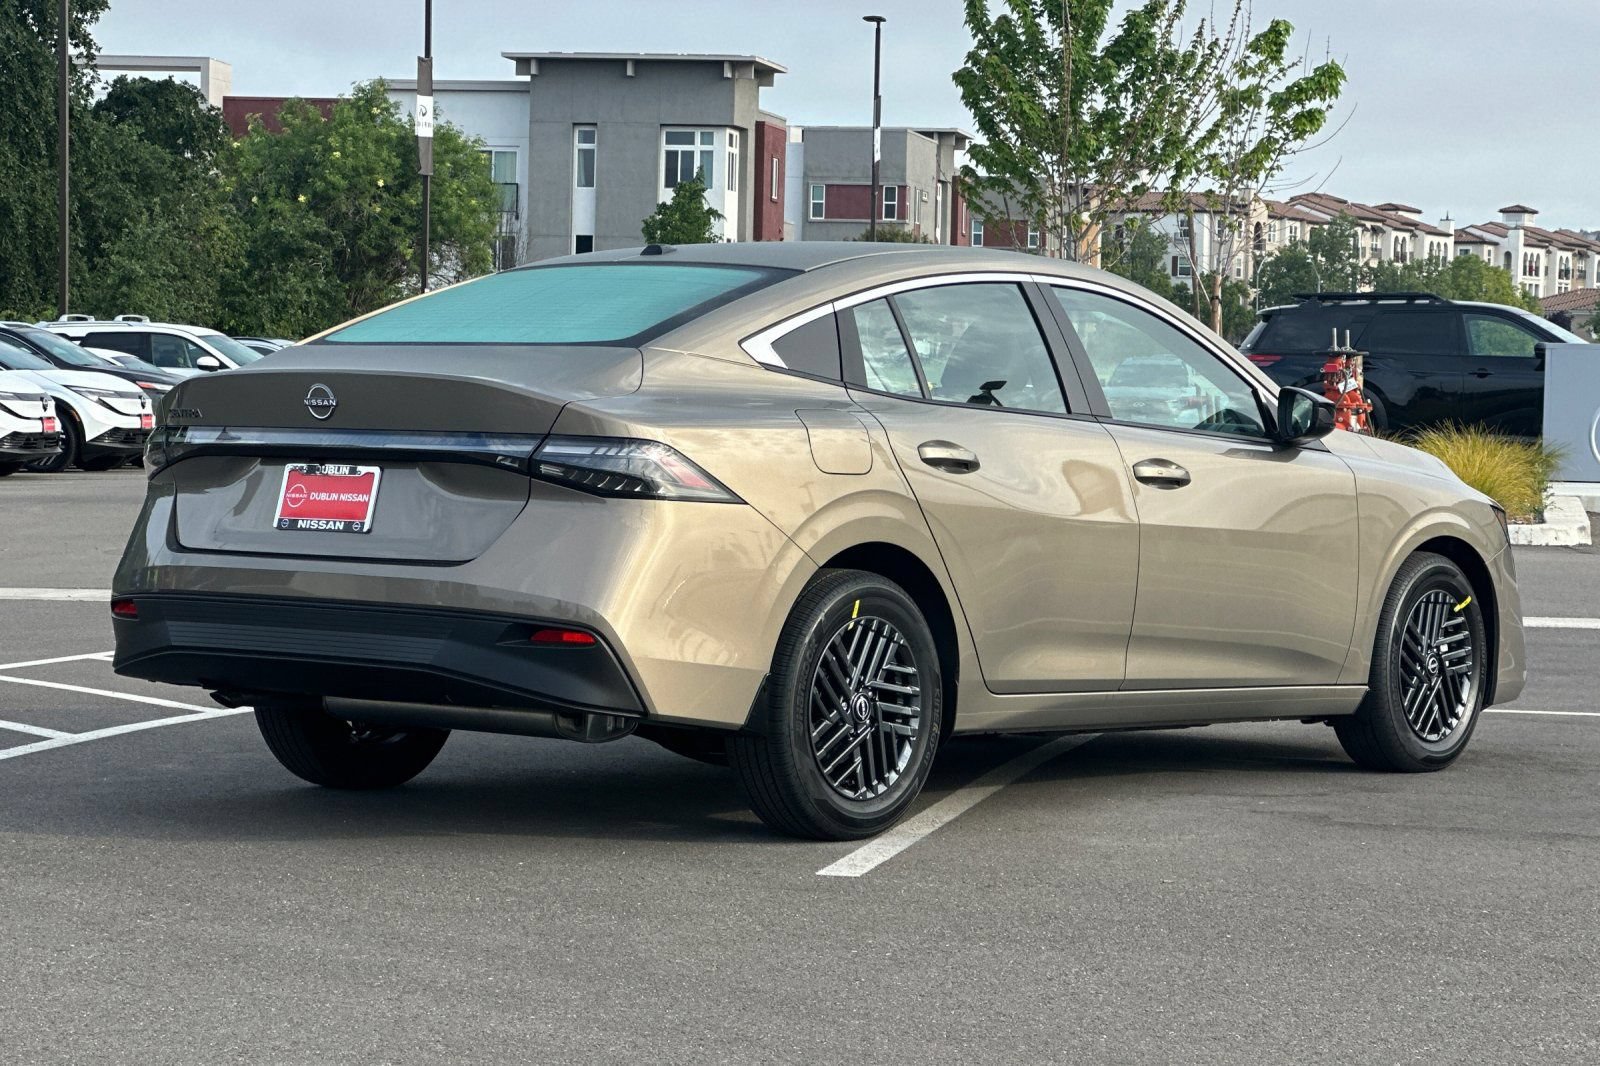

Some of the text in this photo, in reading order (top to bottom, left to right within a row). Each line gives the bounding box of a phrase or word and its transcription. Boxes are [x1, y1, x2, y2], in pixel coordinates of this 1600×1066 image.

[310, 492, 369, 502] DUBLIN NISSAN
[297, 520, 344, 530] NISSAN
